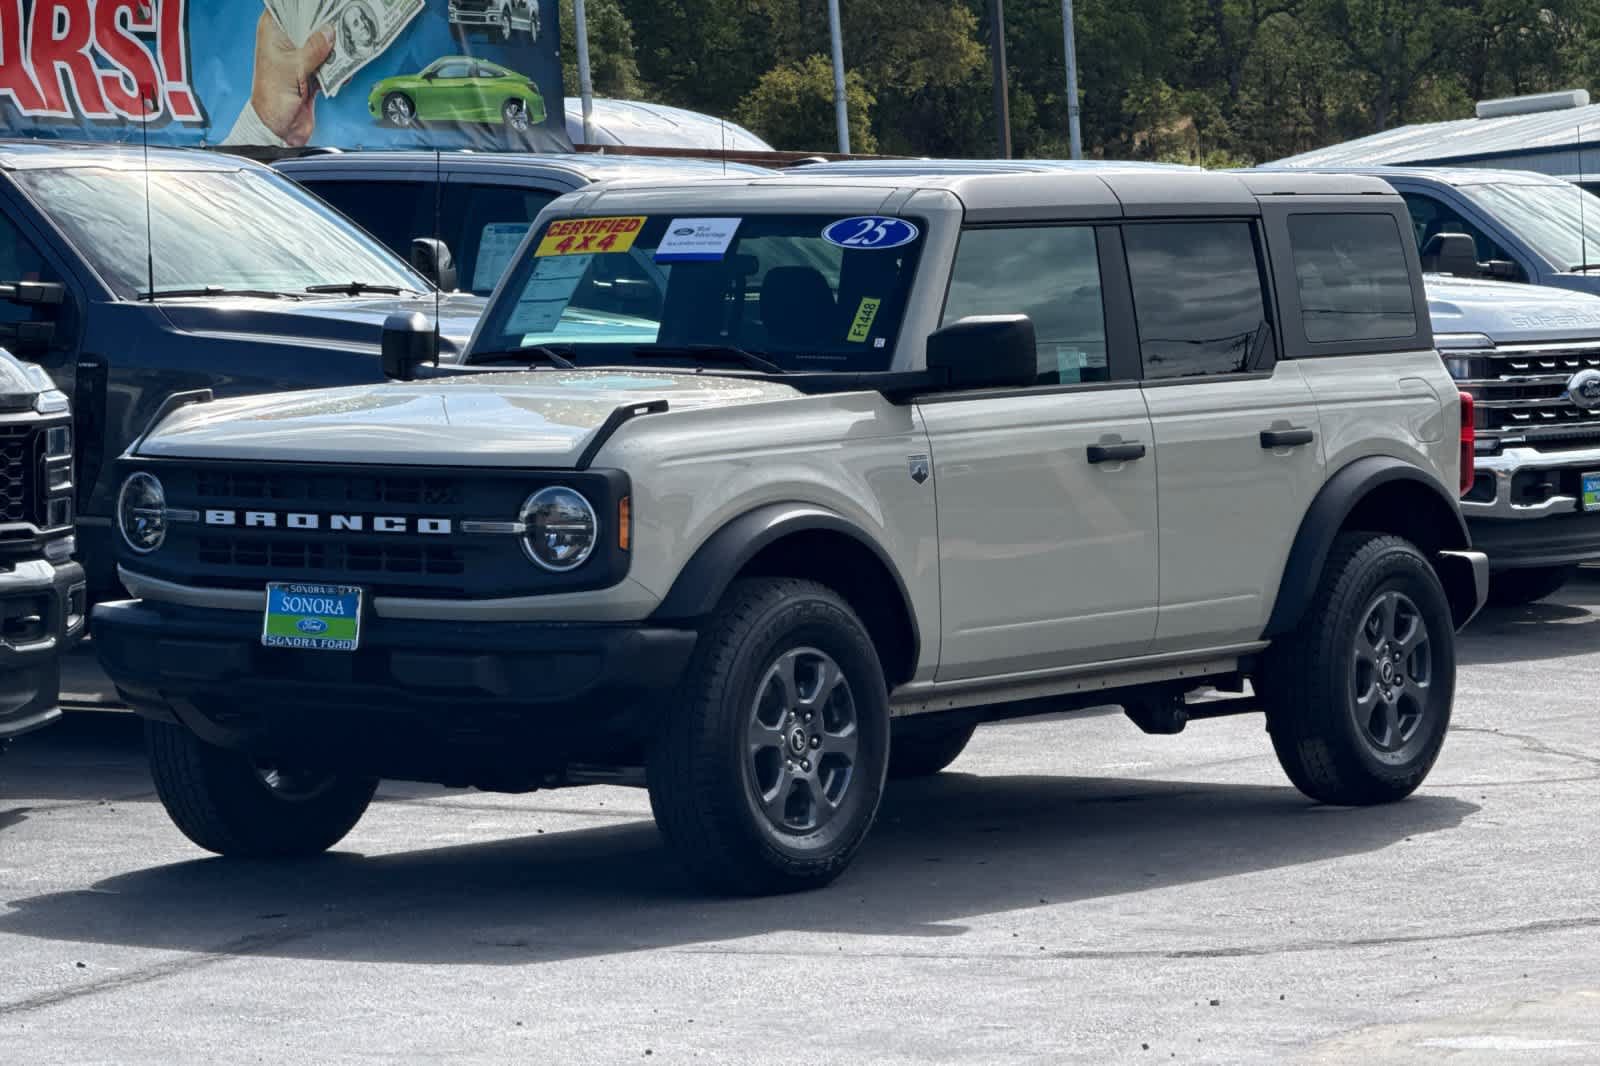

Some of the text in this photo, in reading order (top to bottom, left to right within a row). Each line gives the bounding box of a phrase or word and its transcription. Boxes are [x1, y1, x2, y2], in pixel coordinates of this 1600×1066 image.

[547, 218, 641, 237] CERTIFIED
[842, 219, 896, 245] 25
[852, 303, 876, 336] F1448
[205, 509, 451, 534] BRONCO
[290, 584, 326, 594] SONORA
[281, 596, 345, 615] SONORA
[300, 620, 323, 632] Ford
[268, 635, 351, 650] SONORA FORD
